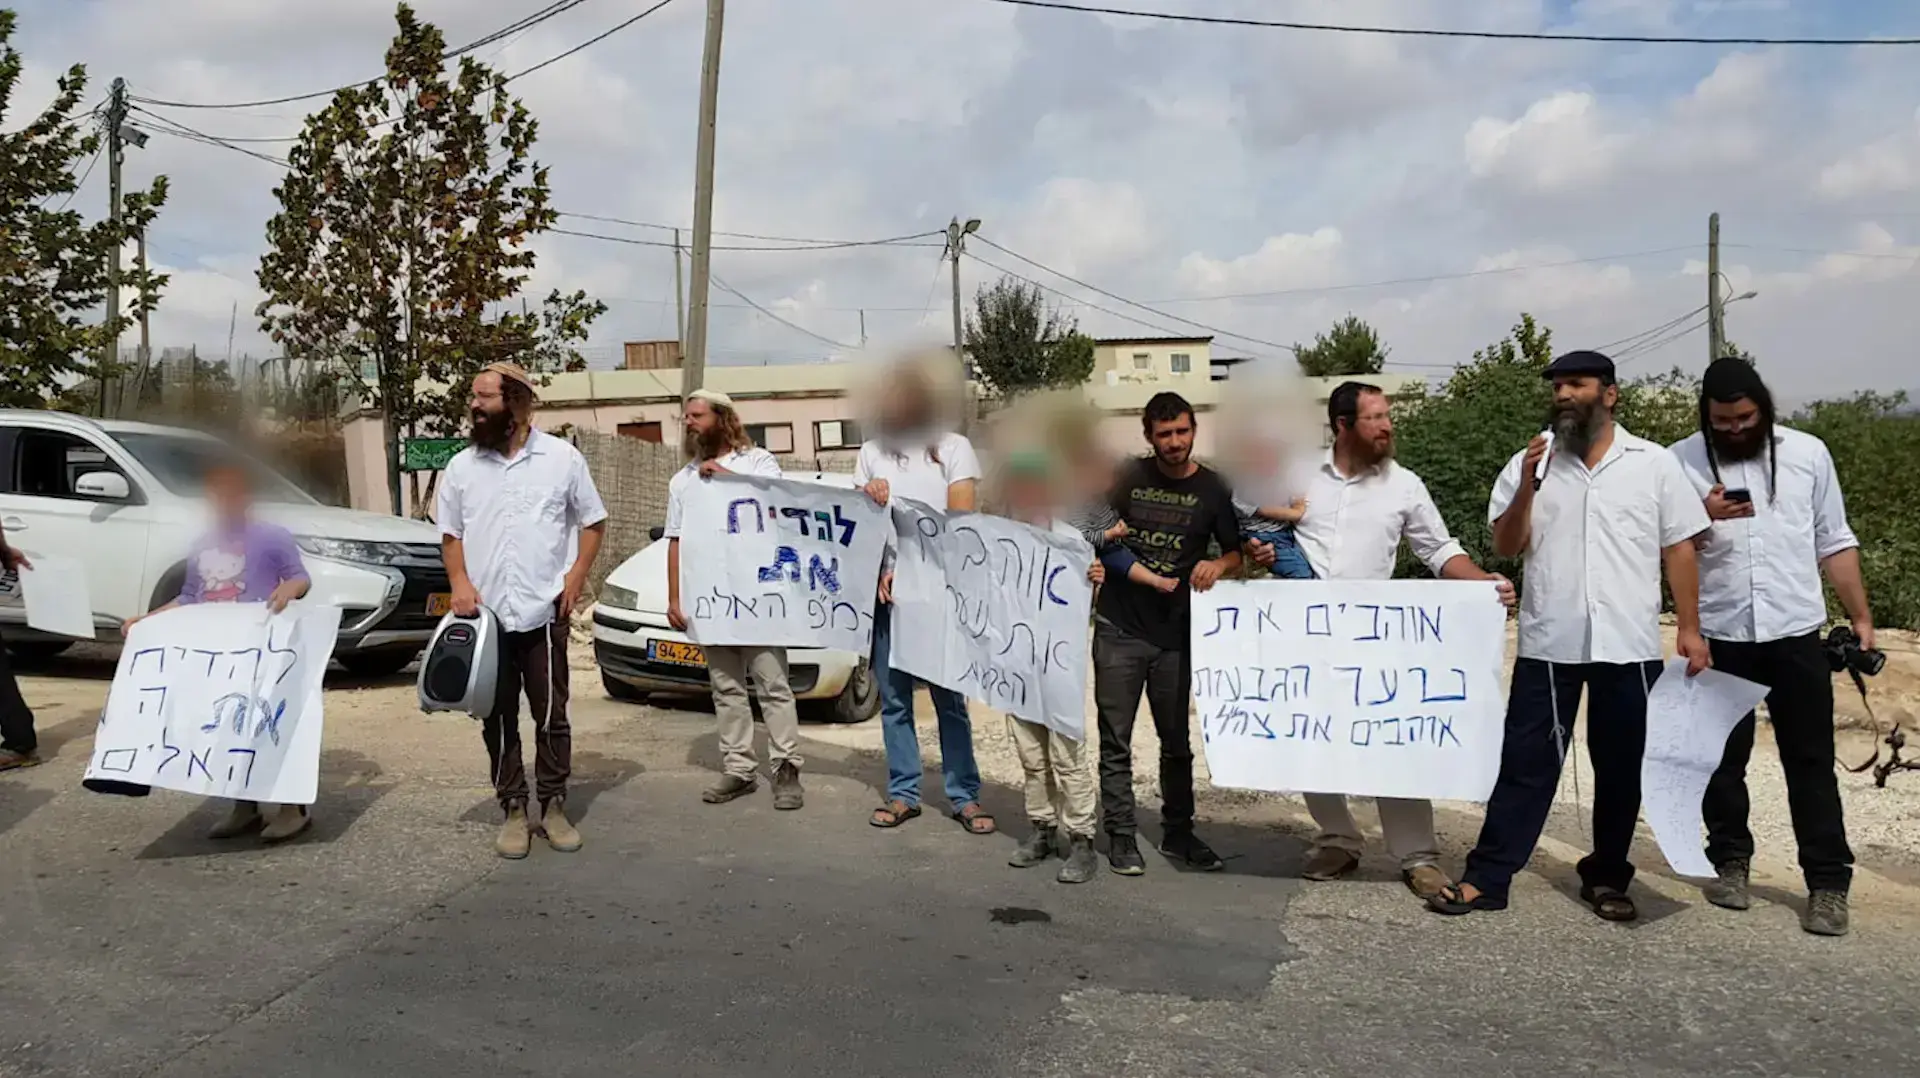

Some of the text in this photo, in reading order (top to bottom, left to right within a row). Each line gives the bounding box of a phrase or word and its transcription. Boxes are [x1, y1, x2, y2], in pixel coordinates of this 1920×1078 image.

[1131, 487, 1180, 505] adidas
[727, 498, 857, 547] להדיח
[758, 546, 842, 595] את
[695, 586, 786, 619] האלים
[1306, 603, 1442, 643] אוהבים
[130, 625, 297, 684] להדיח
[999, 623, 1069, 674] את
[1194, 665, 1310, 703] הגבעות
[201, 692, 286, 746] את
[1285, 714, 1332, 743] את
[1351, 715, 1461, 747] אוהבים
[101, 727, 255, 788] האלים
